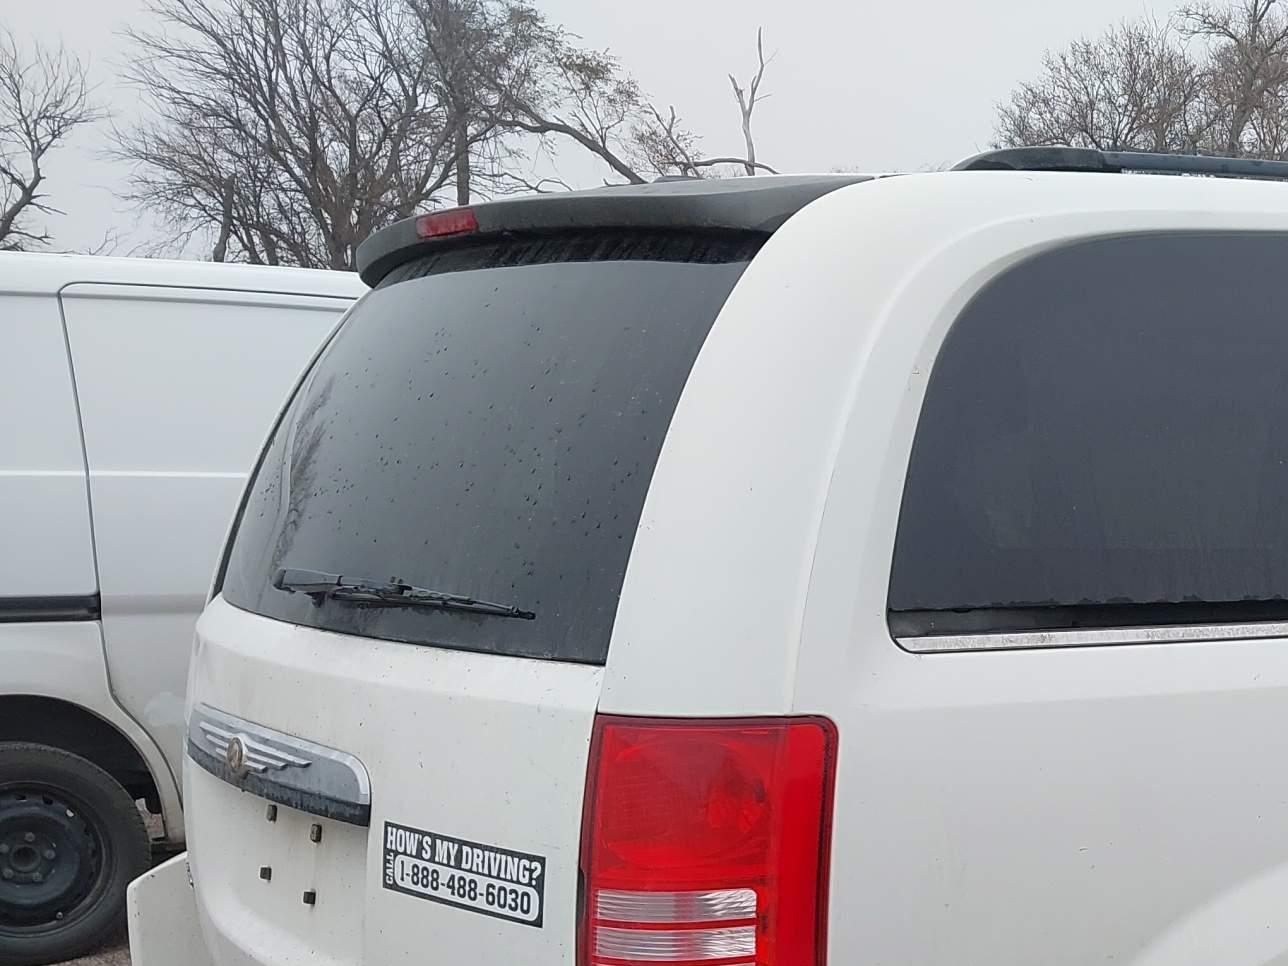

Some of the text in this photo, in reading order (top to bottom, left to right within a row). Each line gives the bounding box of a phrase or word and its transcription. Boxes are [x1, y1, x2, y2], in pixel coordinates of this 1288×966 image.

[386, 826, 542, 886] HOW'S MY DRIVING?
[386, 852, 395, 885] CALL
[400, 860, 531, 915] 1-888-488-6030
